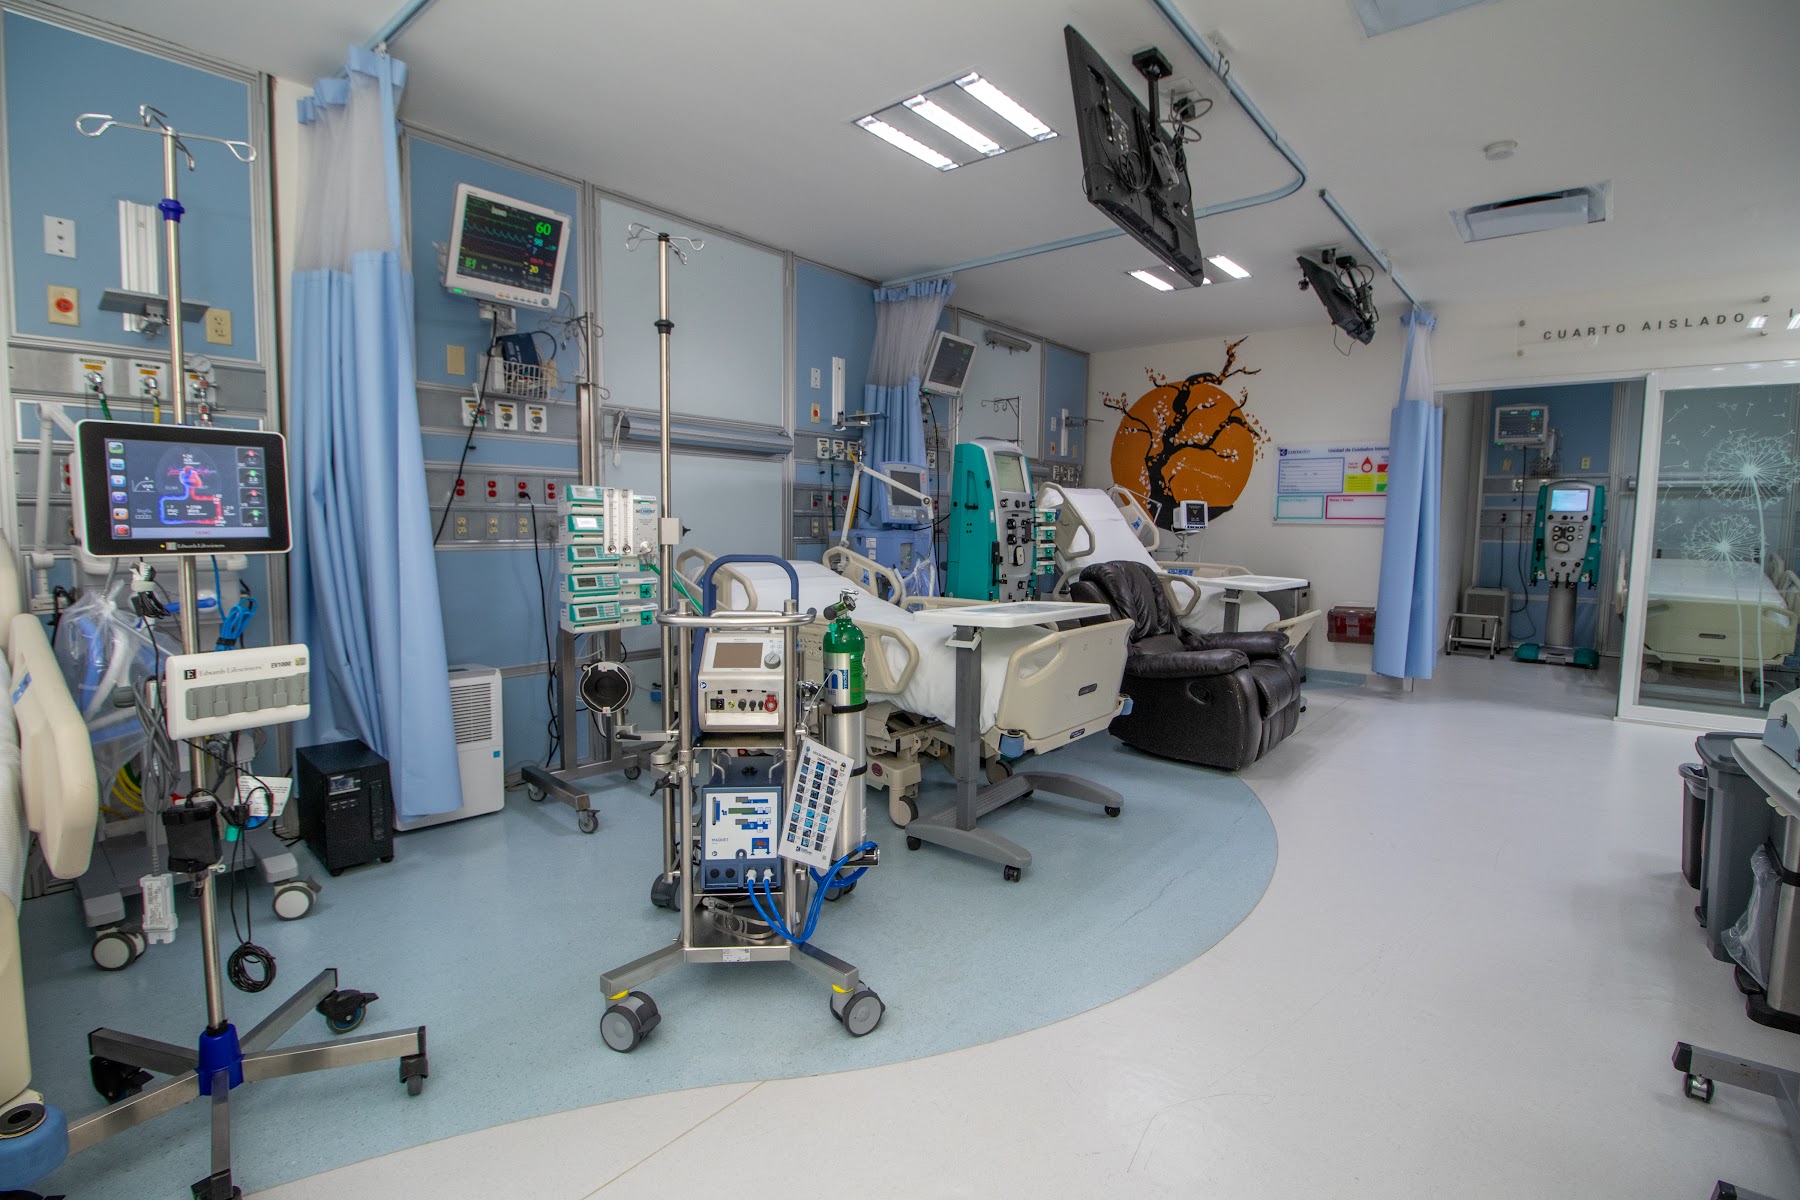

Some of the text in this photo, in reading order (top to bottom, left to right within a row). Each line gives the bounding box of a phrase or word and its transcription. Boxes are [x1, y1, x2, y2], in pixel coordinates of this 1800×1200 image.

[536, 222, 551, 235] 60
[1543, 324, 1626, 341] CUARTO
[1641, 313, 1745, 331] AISLADO
[199, 668, 226, 677] Edwards
[226, 665, 262, 674] Lifesciences
